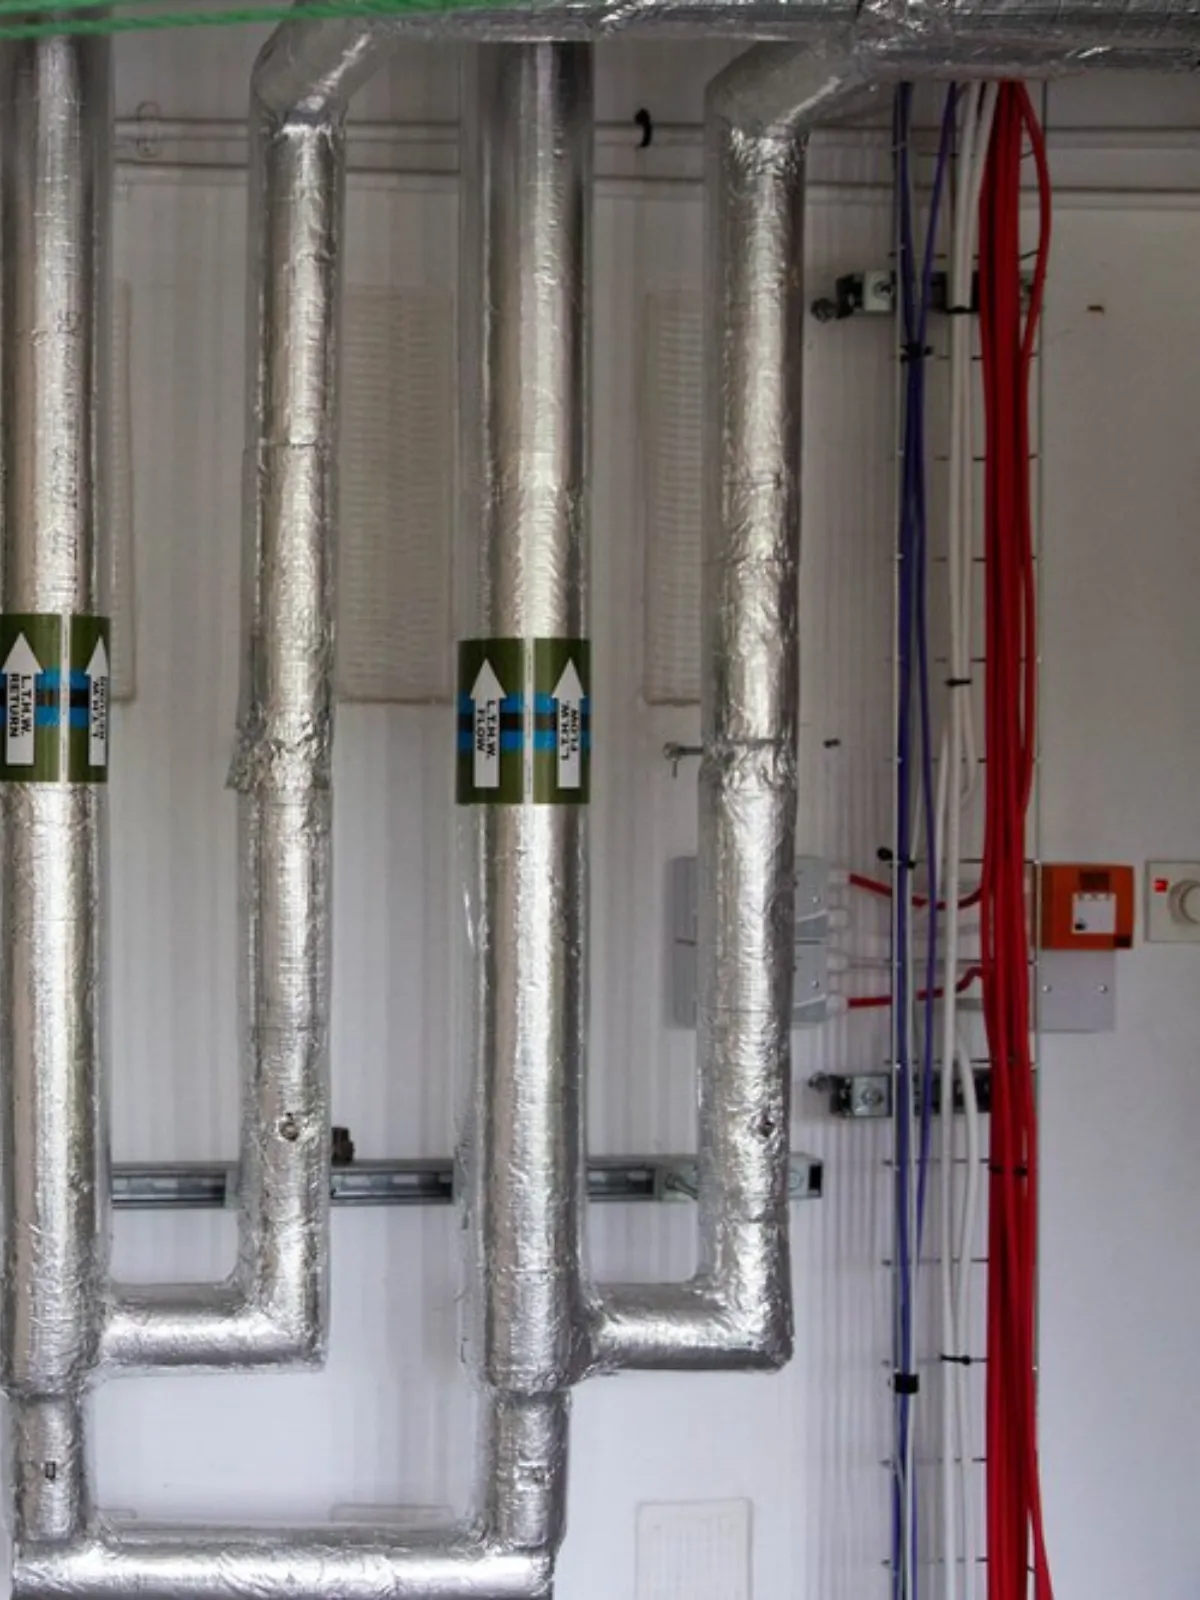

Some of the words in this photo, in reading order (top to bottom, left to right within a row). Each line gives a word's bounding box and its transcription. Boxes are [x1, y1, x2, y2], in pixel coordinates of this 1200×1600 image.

[9, 673, 20, 738] RETURN
[21, 674, 32, 737] L.T.H.W.
[477, 709, 485, 752] FLOW
